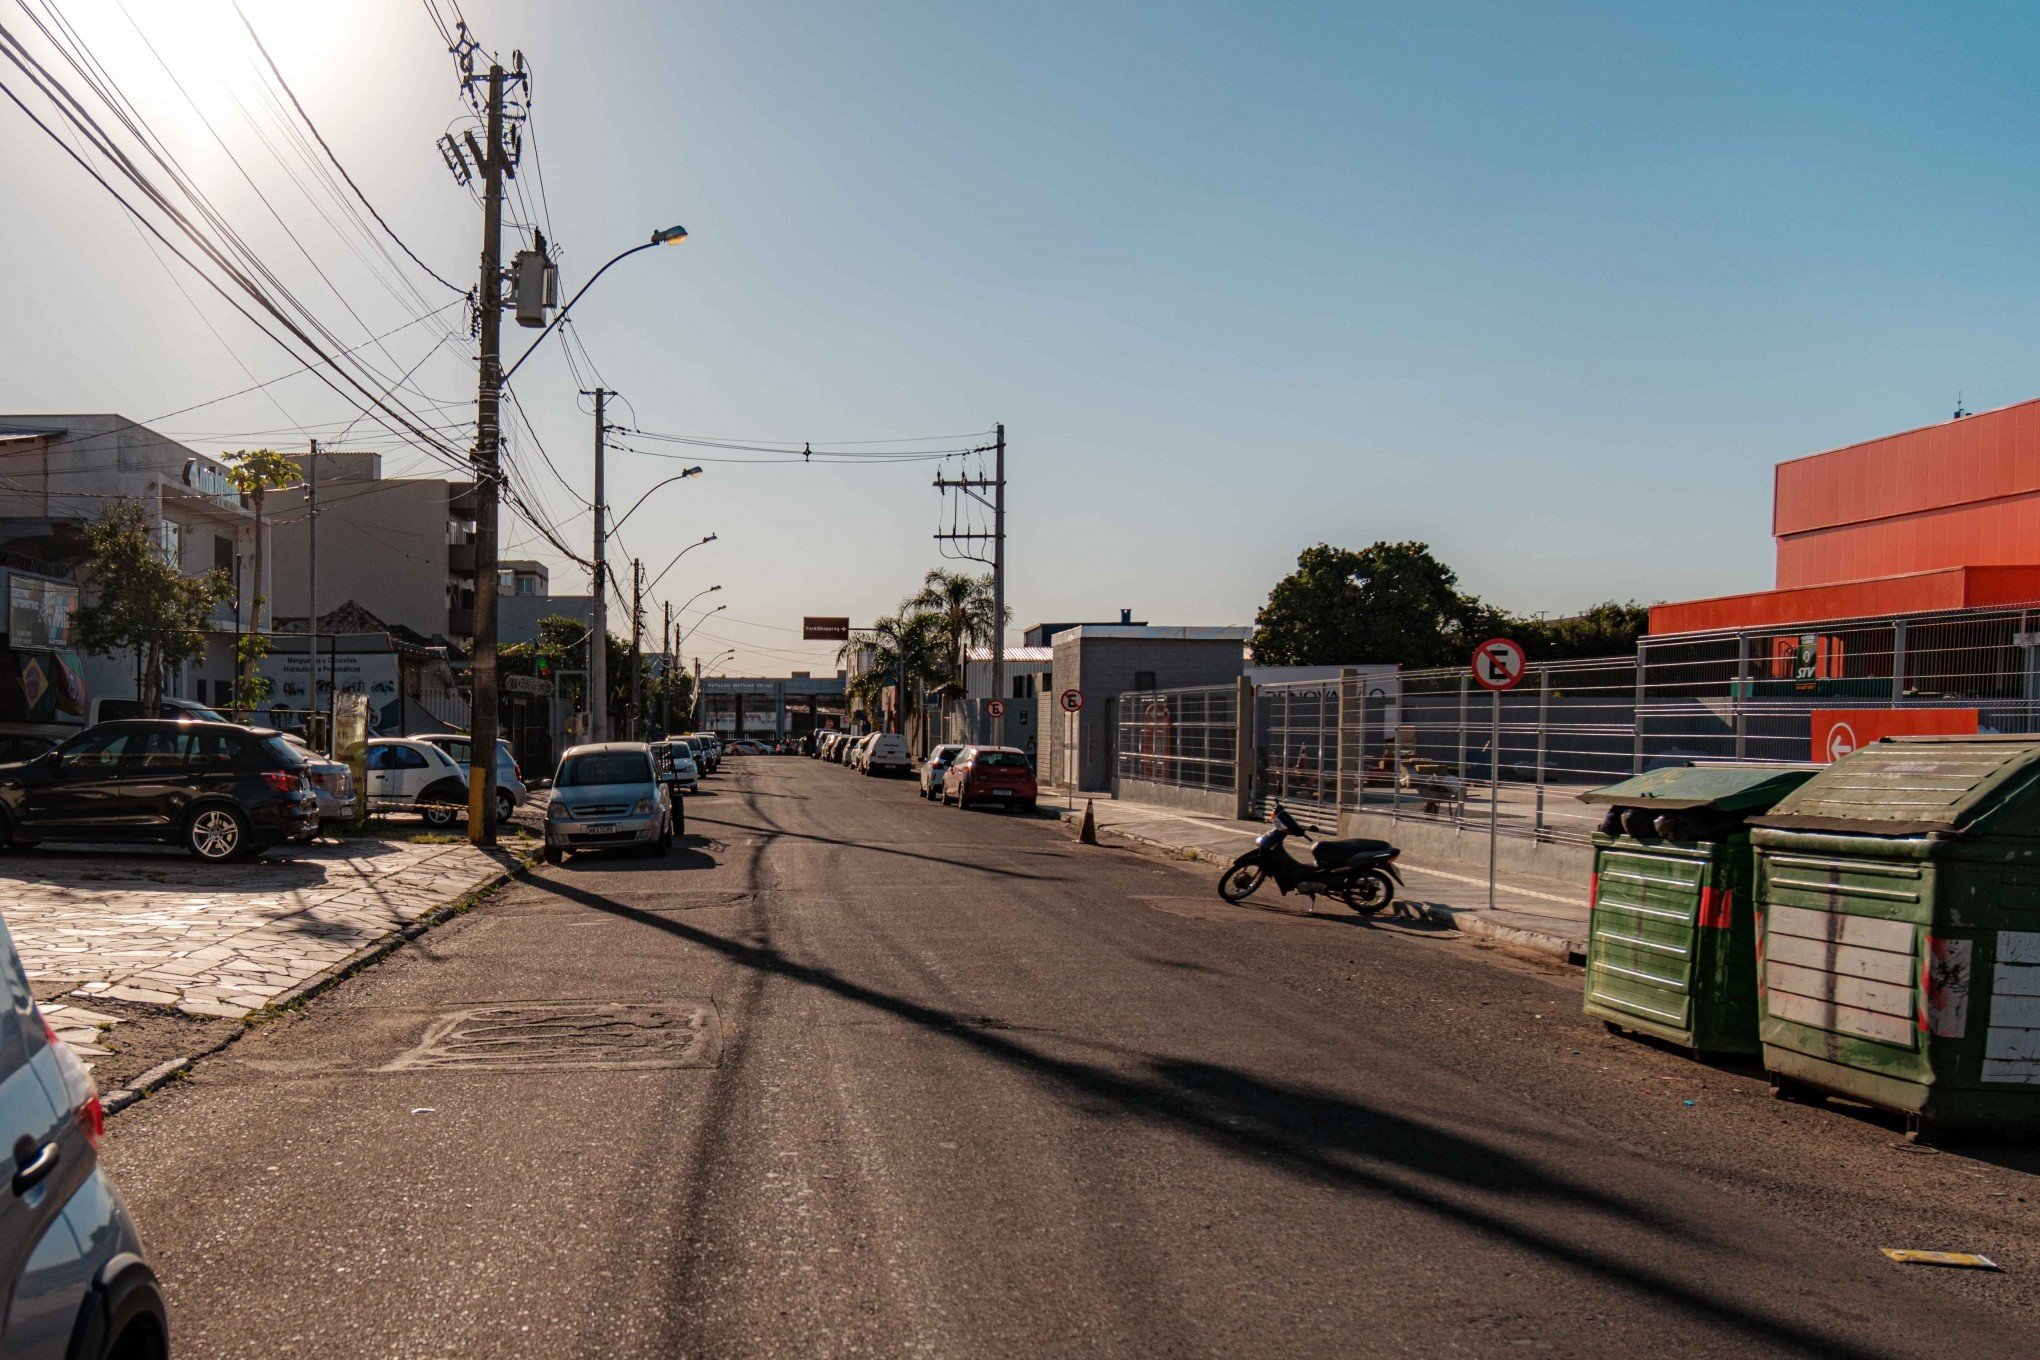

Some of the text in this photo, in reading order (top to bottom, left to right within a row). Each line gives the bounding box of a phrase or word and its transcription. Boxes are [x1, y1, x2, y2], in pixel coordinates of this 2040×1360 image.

[287, 657, 321, 665] Mangueas
[327, 656, 357, 664] Cnexões
[323, 665, 361, 673] Pnumáticas
[1797, 667, 1815, 679] STV
